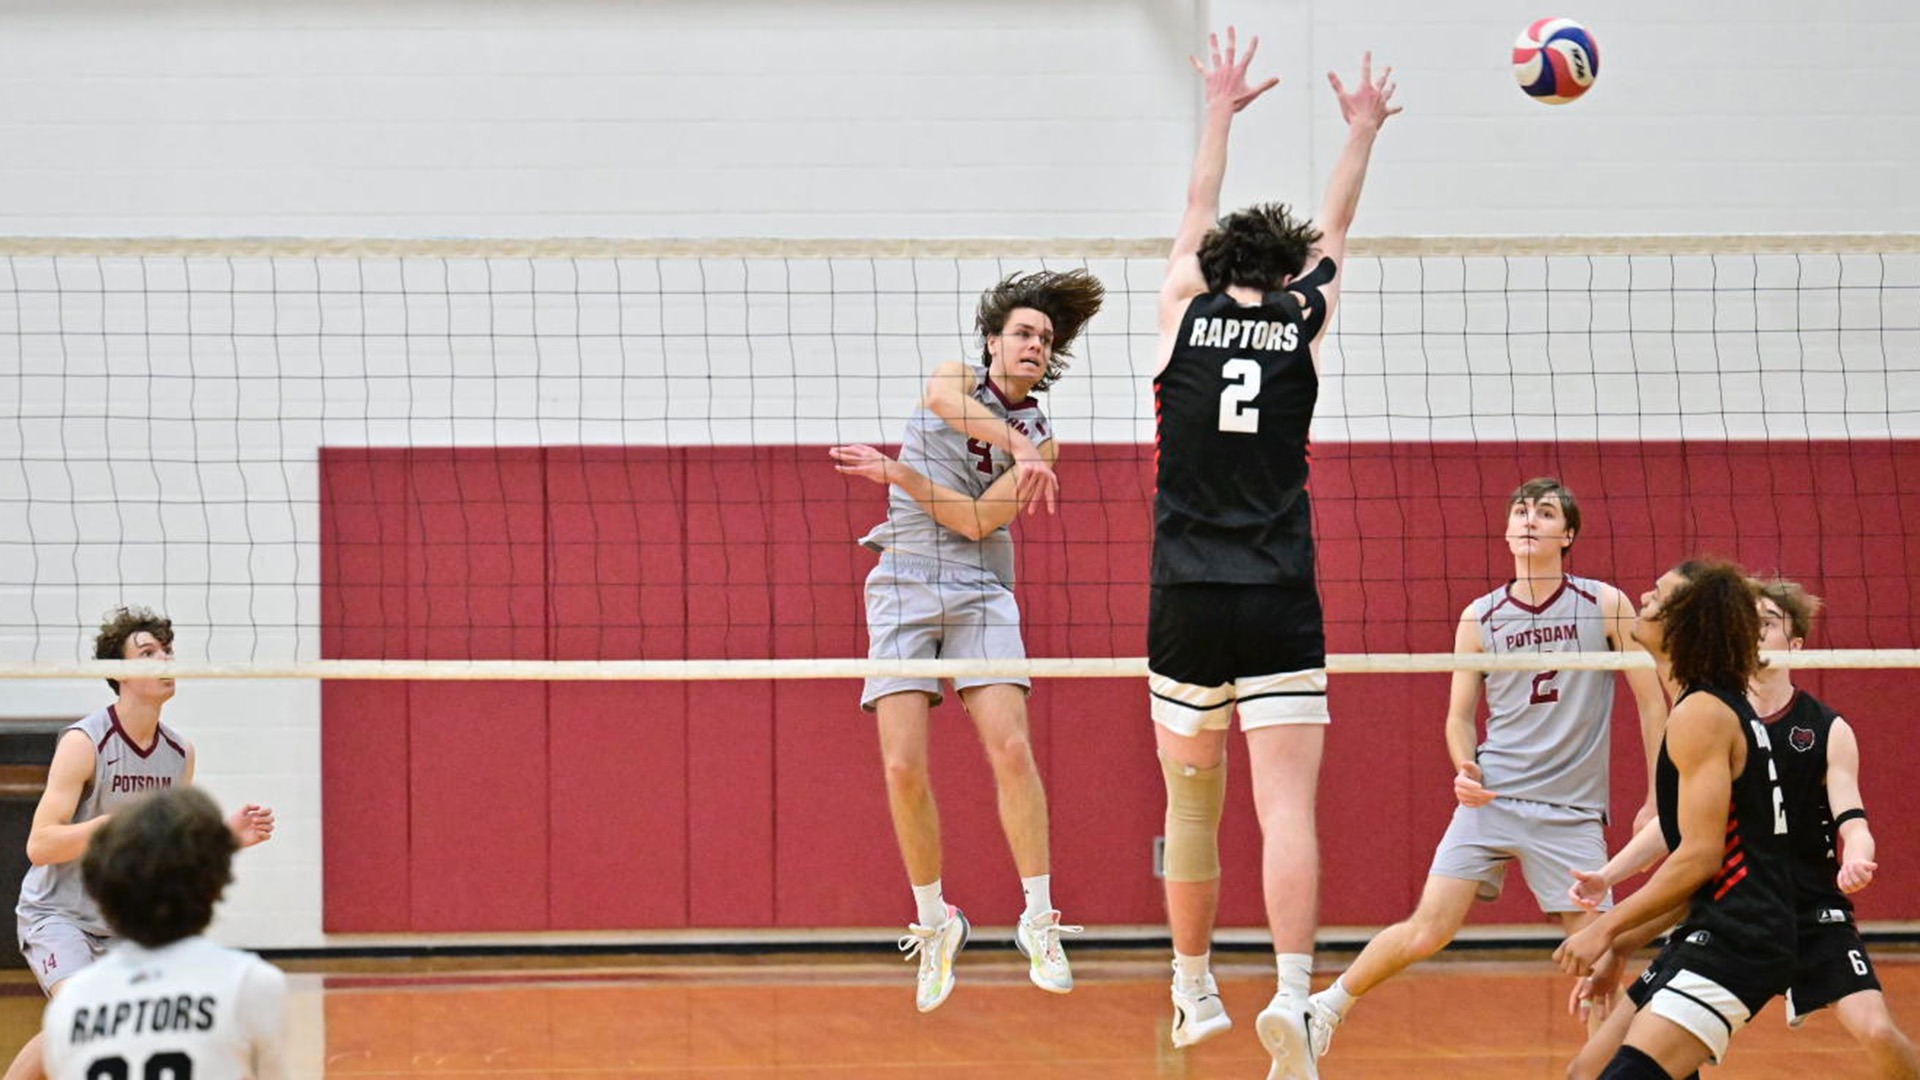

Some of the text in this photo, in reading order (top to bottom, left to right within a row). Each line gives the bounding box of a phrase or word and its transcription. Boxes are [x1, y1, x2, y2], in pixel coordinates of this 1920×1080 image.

[1188, 317, 1299, 352] RAPTORS
[1218, 358, 1262, 434] 2
[1506, 624, 1578, 650] POTSDAM
[1529, 650, 1559, 705] 2
[42, 953, 57, 975] 14
[1847, 949, 1869, 976] 6
[71, 995, 215, 1043] RAPTORS
